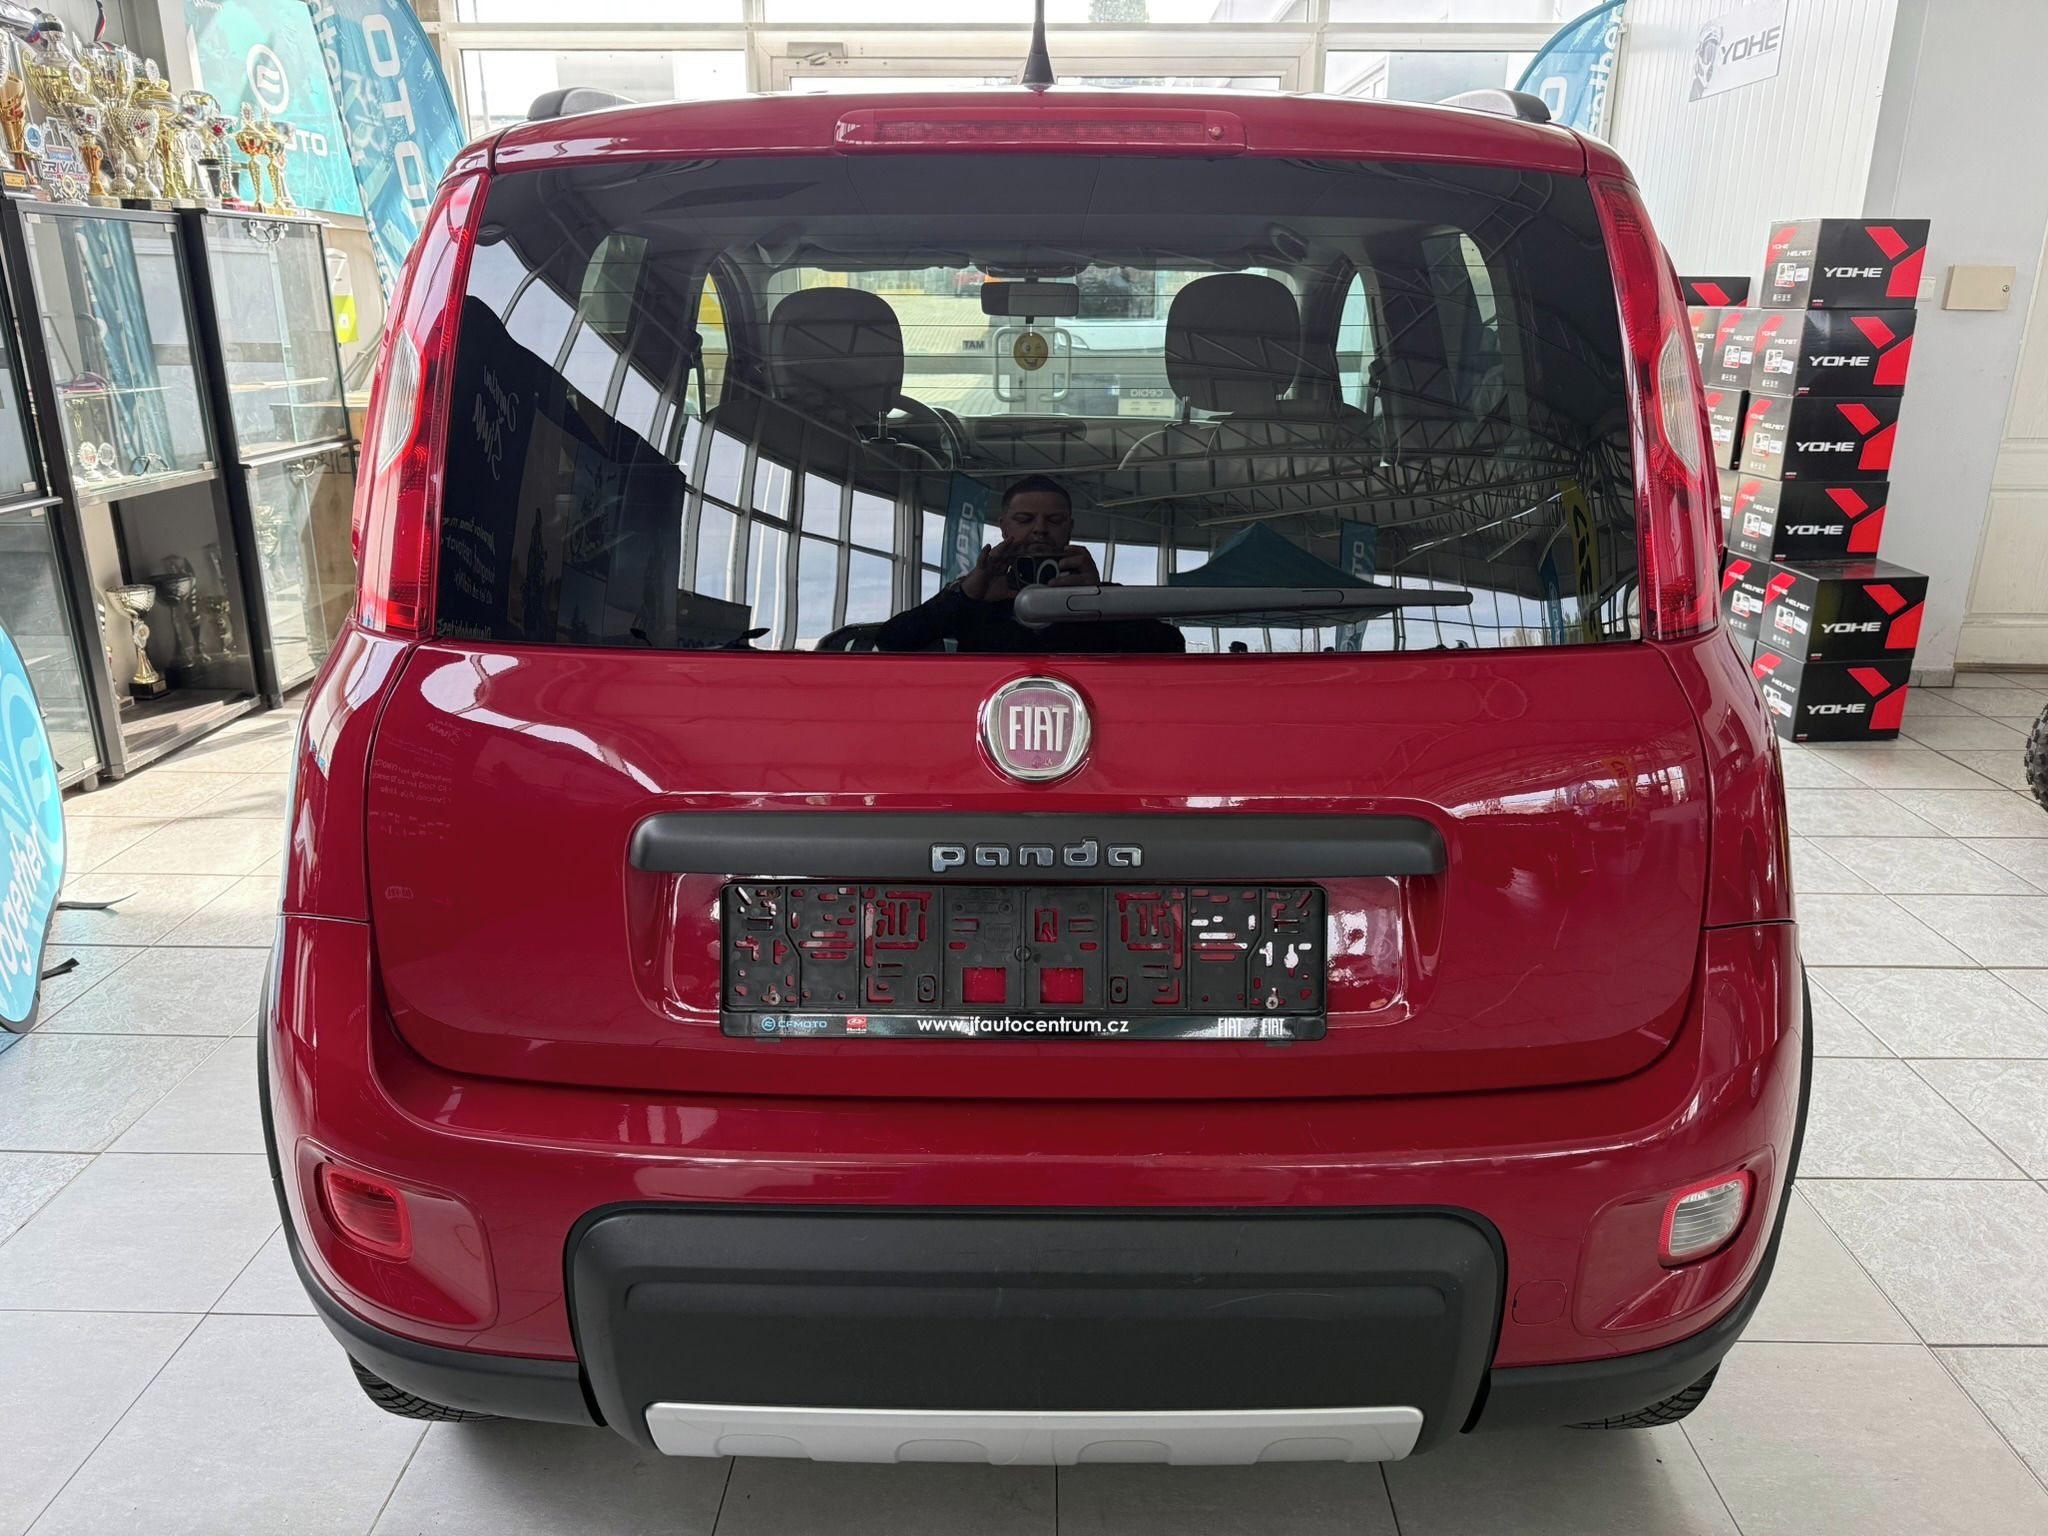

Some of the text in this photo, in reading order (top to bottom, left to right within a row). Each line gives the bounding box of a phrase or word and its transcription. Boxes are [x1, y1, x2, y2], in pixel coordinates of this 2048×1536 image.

[1720, 25, 1781, 65] YOHE
[1824, 266, 1883, 278] YOHE
[1808, 355, 1870, 367] YOHE
[1796, 441, 1855, 453] YOHE
[1785, 524, 1844, 536] YOHE
[1785, 597, 1811, 612] HELMET
[1821, 622, 1882, 634] YOHE
[1771, 677, 1796, 693] HELMET
[1806, 703, 1866, 715] YOHE
[1008, 704, 1069, 753] FIAT
[931, 838, 1142, 872] panda
[917, 1016, 1129, 1036] www.jfautocentrum.cz
[1218, 1018, 1243, 1038] FIAT
[1261, 1018, 1285, 1036] FIAT
